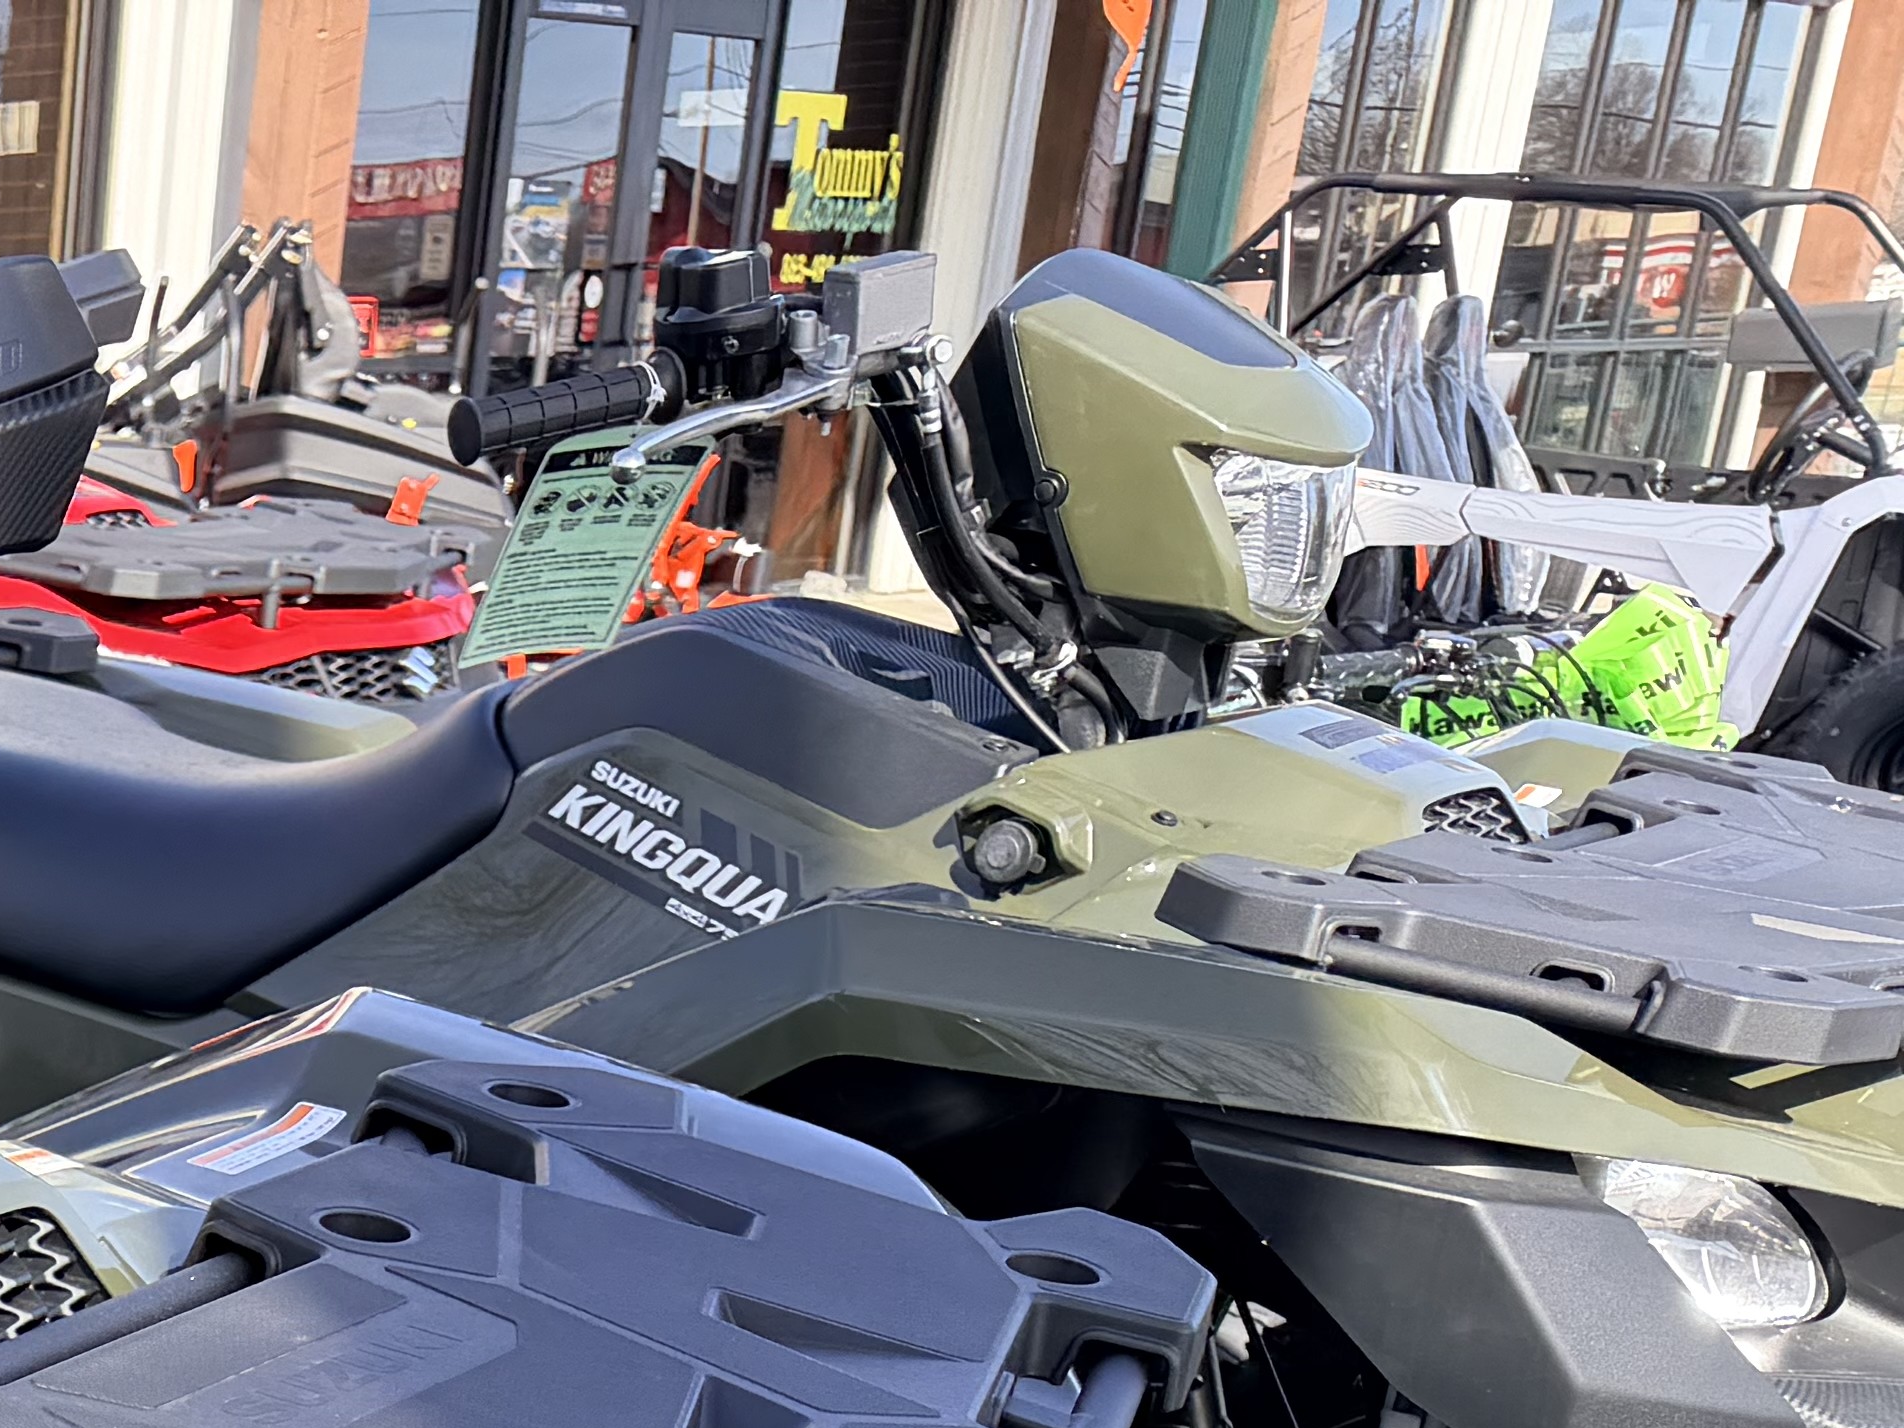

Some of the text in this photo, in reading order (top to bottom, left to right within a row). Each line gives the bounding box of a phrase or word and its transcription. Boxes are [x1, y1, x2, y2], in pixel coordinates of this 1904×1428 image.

[772, 89, 903, 230] Tommy's
[547, 784, 788, 925] KINGQUA
[591, 760, 681, 818] SUZUKI
